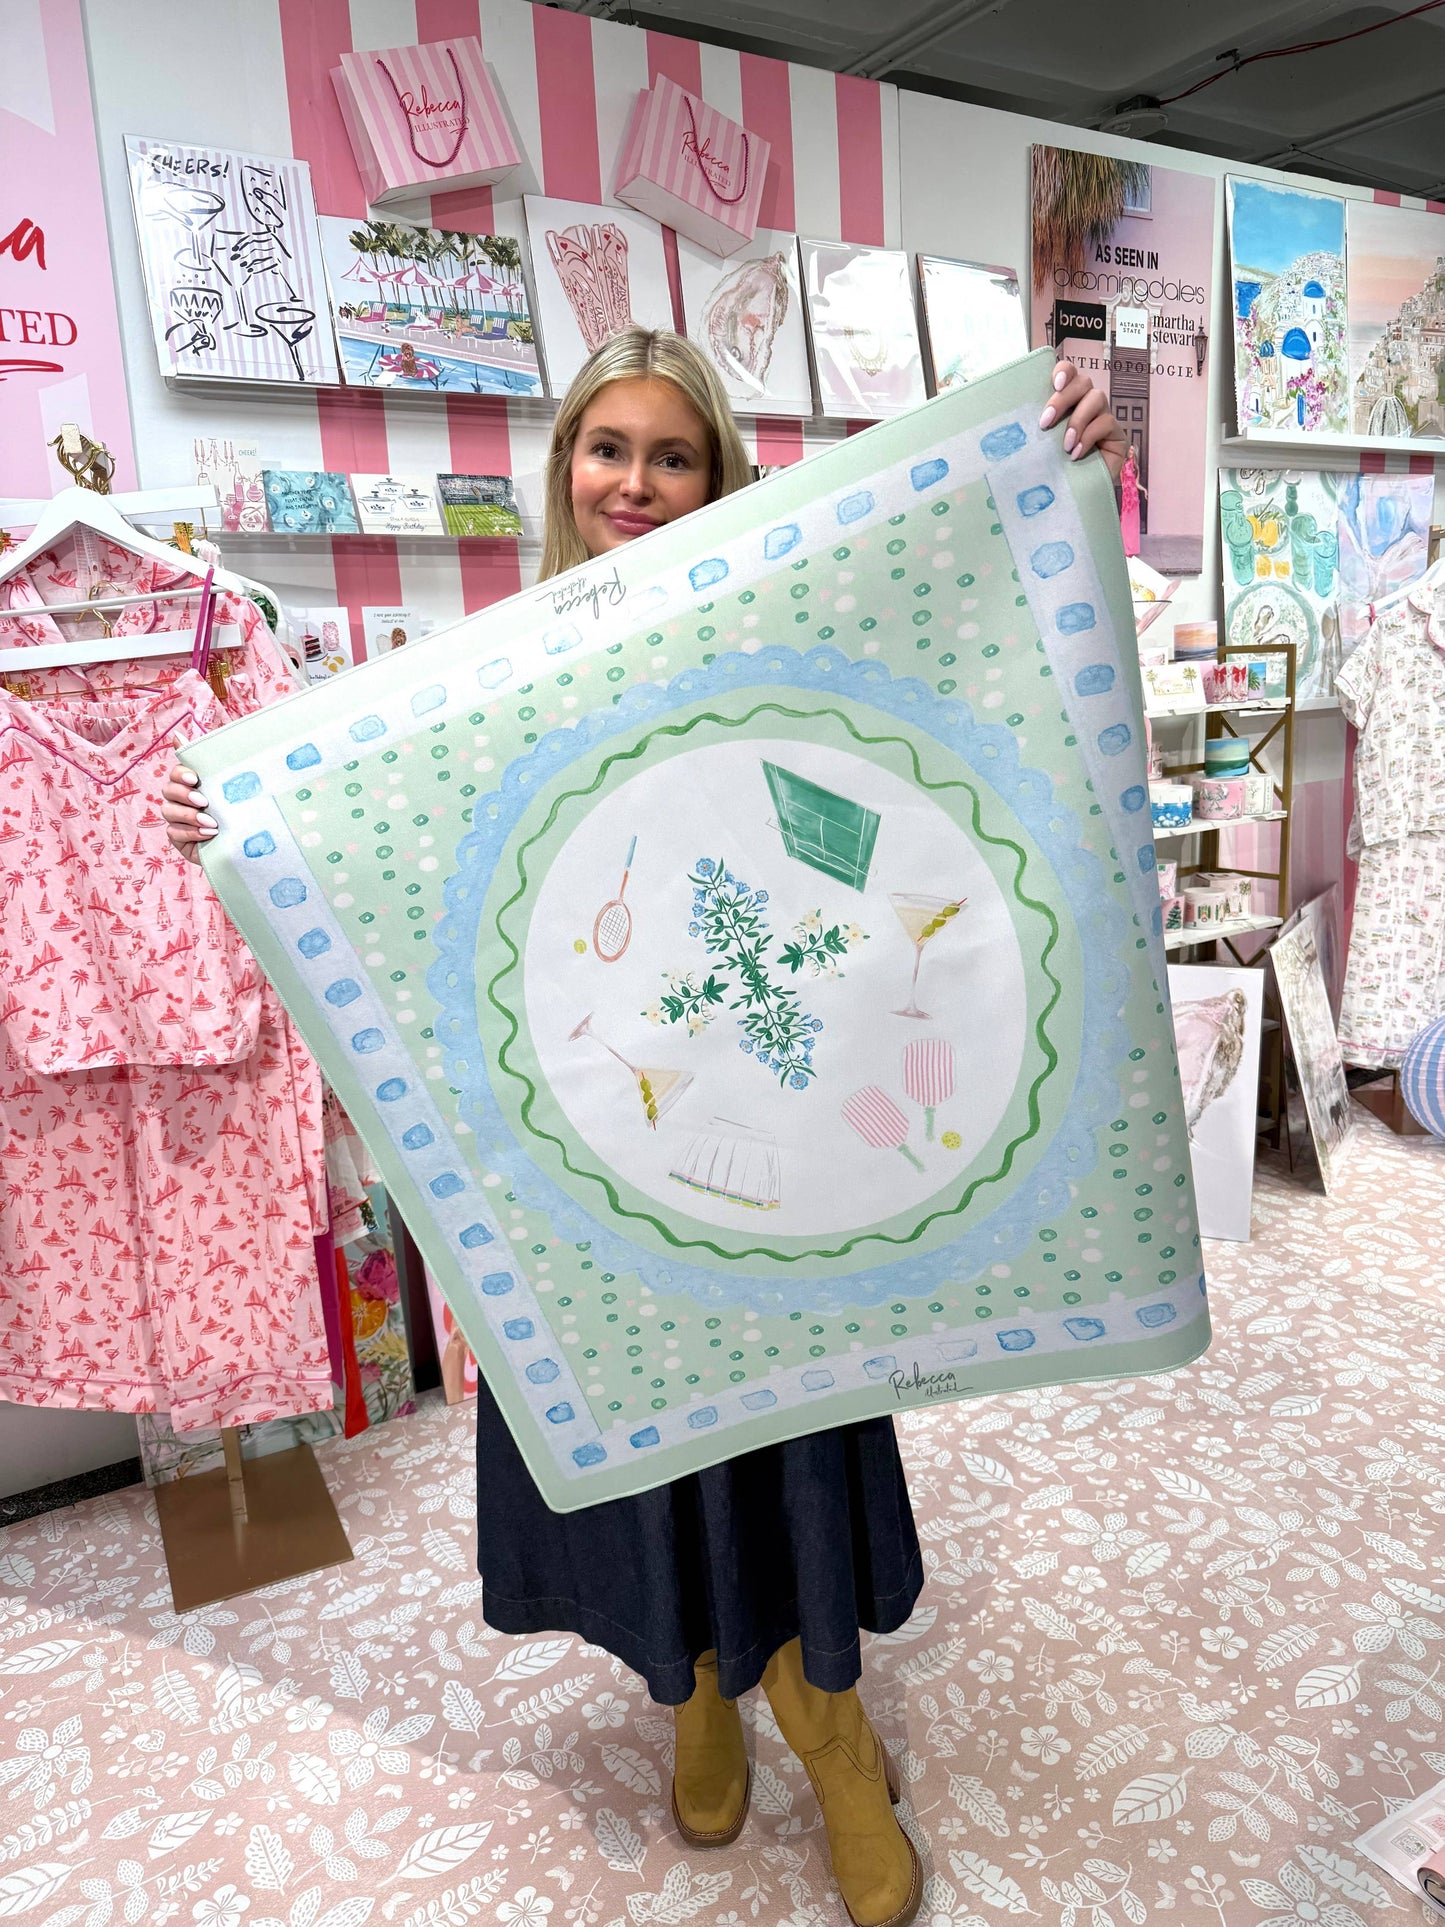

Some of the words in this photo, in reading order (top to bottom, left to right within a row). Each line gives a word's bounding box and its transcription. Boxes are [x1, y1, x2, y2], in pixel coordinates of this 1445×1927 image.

[400, 85, 460, 118] Rebecca
[151, 155, 229, 178] CHEERS!
[1095, 244, 1111, 263] AS
[1114, 246, 1144, 268] SEEN
[1147, 251, 1159, 270] IN
[1053, 263, 1205, 305] bloomingdale's
[1059, 309, 1103, 330] bravo
[1122, 327, 1142, 335] STATE
[1152, 314, 1195, 332] martha
[1152, 328, 1196, 347] stewart
[554, 567, 626, 619] Rebecca
[889, 1361, 956, 1400] Rebecca
